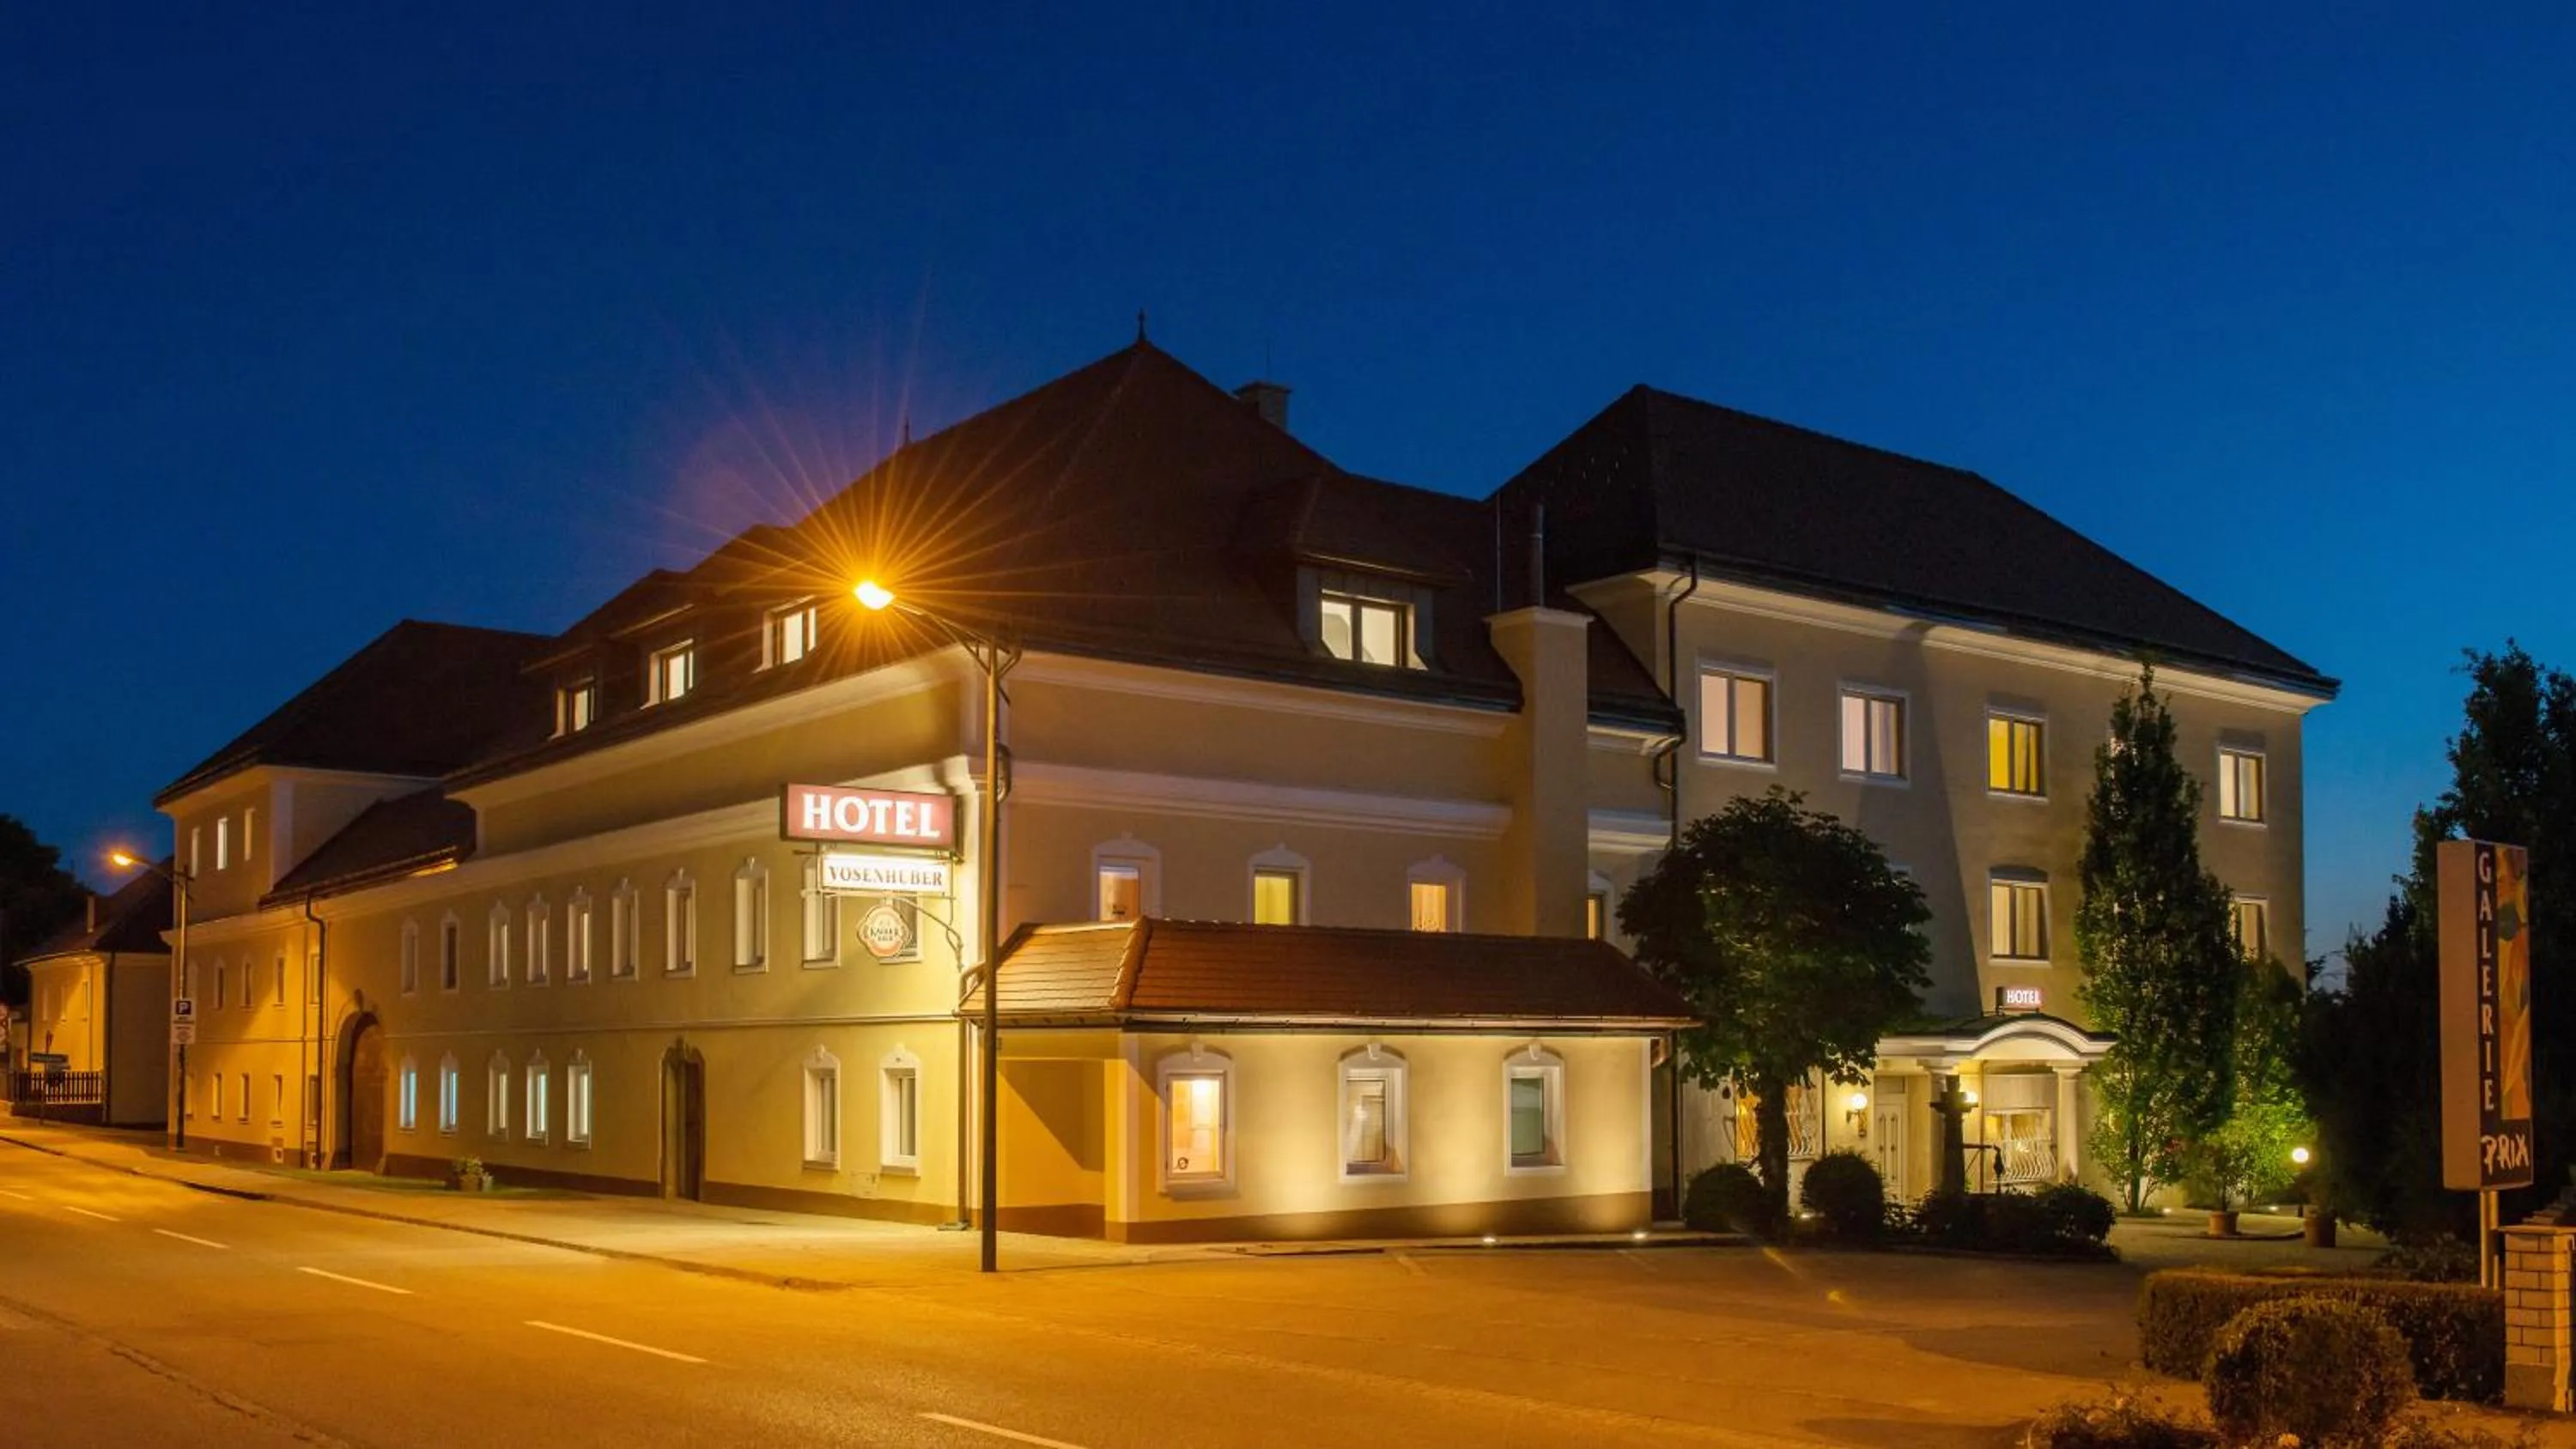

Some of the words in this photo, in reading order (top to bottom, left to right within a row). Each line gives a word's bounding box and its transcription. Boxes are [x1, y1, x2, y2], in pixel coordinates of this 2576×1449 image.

[803, 793, 939, 837] HOTEL
[829, 865, 942, 887] VOSENHUBER
[2007, 989, 2040, 1003] HOTEL
[2478, 851, 2494, 1111] GALERIE
[2481, 1133, 2529, 1175] PRIX
